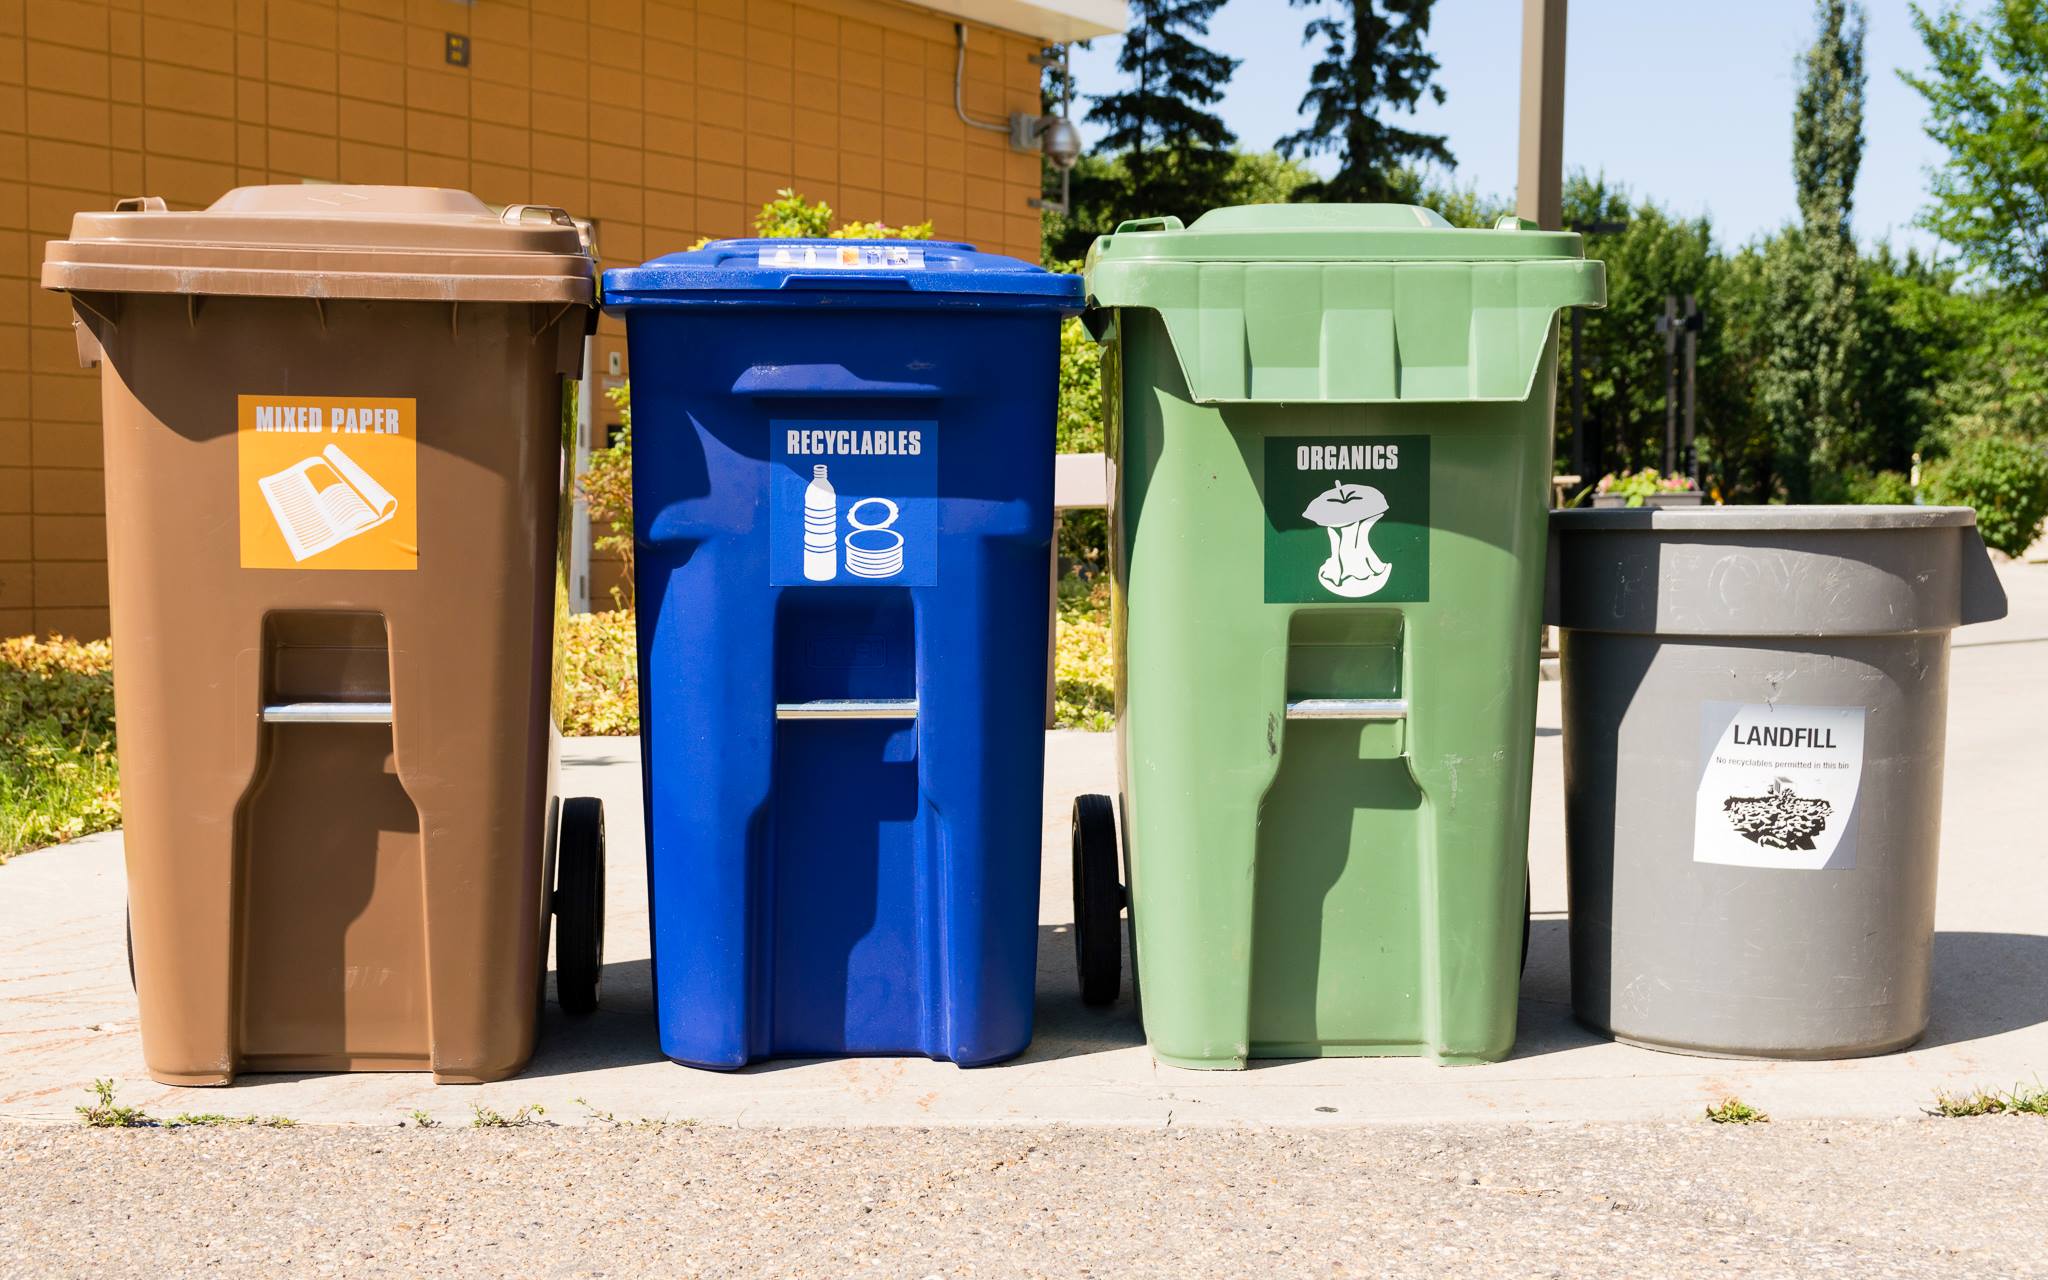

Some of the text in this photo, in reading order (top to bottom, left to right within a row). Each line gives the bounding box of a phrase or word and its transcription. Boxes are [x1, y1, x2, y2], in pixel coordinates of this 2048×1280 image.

[255, 406, 400, 435] MIXED PAPER
[787, 429, 921, 456] RECYCLABLES
[1296, 444, 1399, 471] ORGANICS
[1733, 724, 1837, 749] LANDFILL
[1716, 756, 1849, 770] No recyclables permitted in this bin
